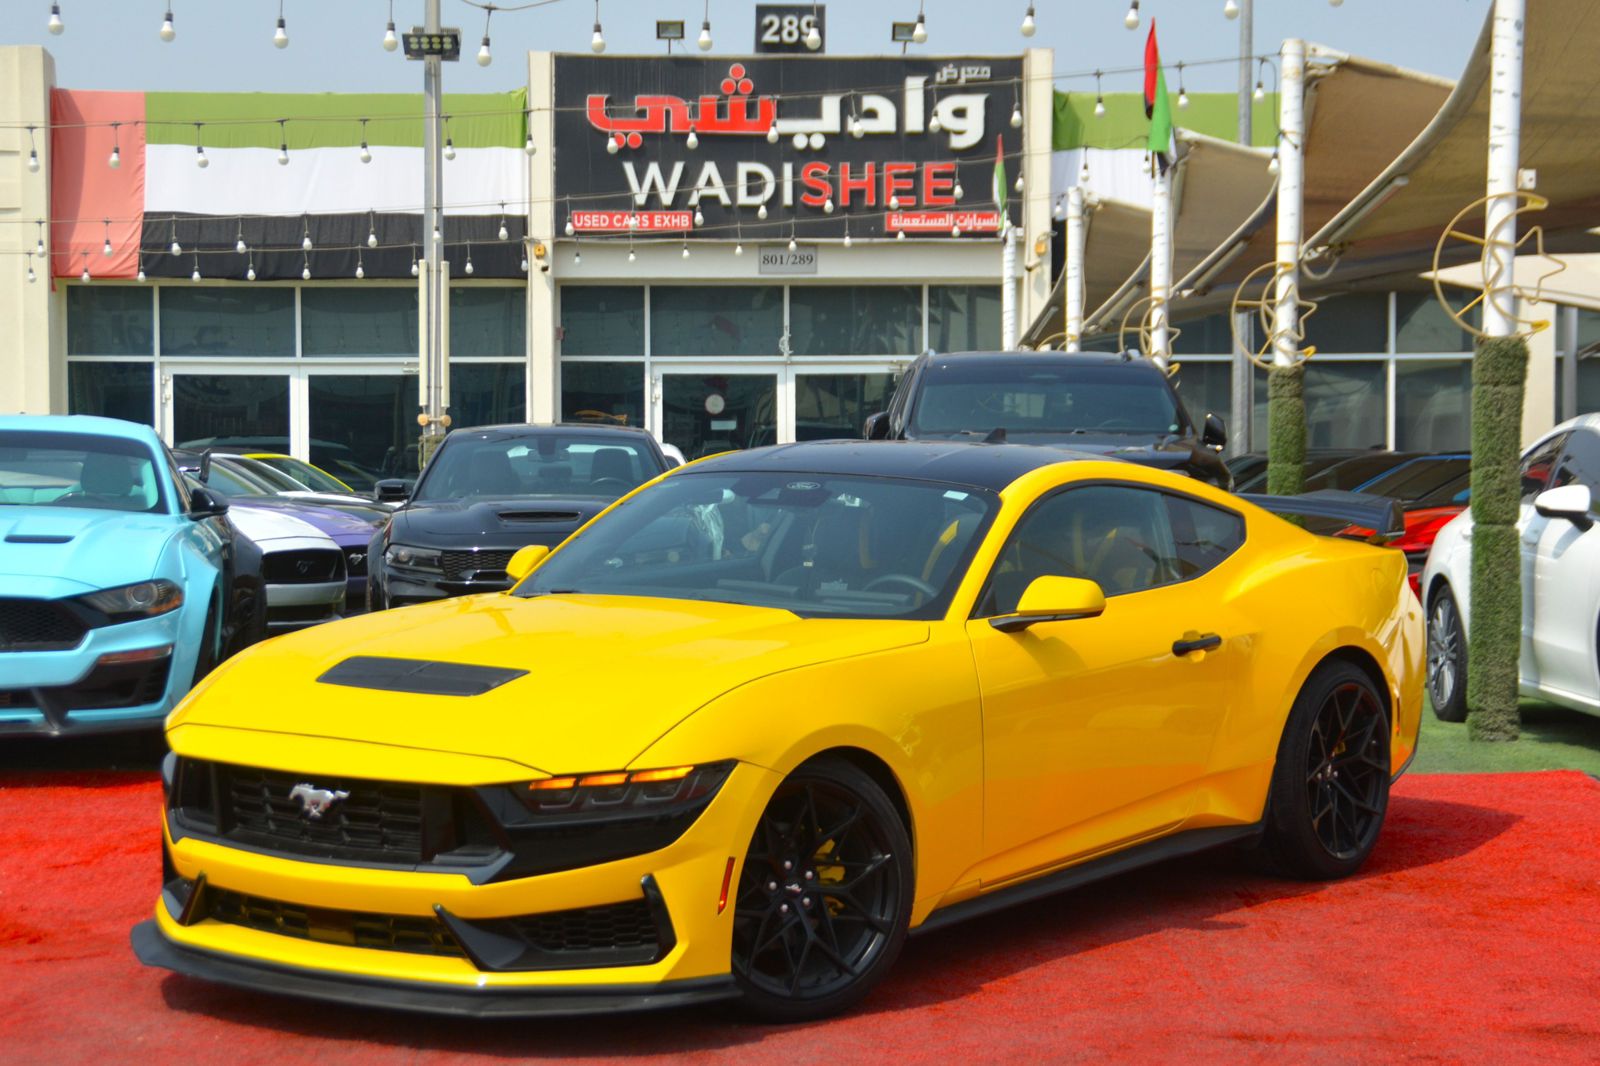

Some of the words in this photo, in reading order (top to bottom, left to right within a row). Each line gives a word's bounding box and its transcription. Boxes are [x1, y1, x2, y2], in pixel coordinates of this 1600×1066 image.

[761, 14, 819, 43] 289
[936, 63, 991, 85] معرض
[622, 160, 957, 207] WADISHEE
[574, 214, 610, 227] USED
[613, 214, 649, 227] CARS
[654, 214, 690, 227] EXHB
[891, 212, 954, 227] المستعملة
[762, 254, 814, 265] 801/289
